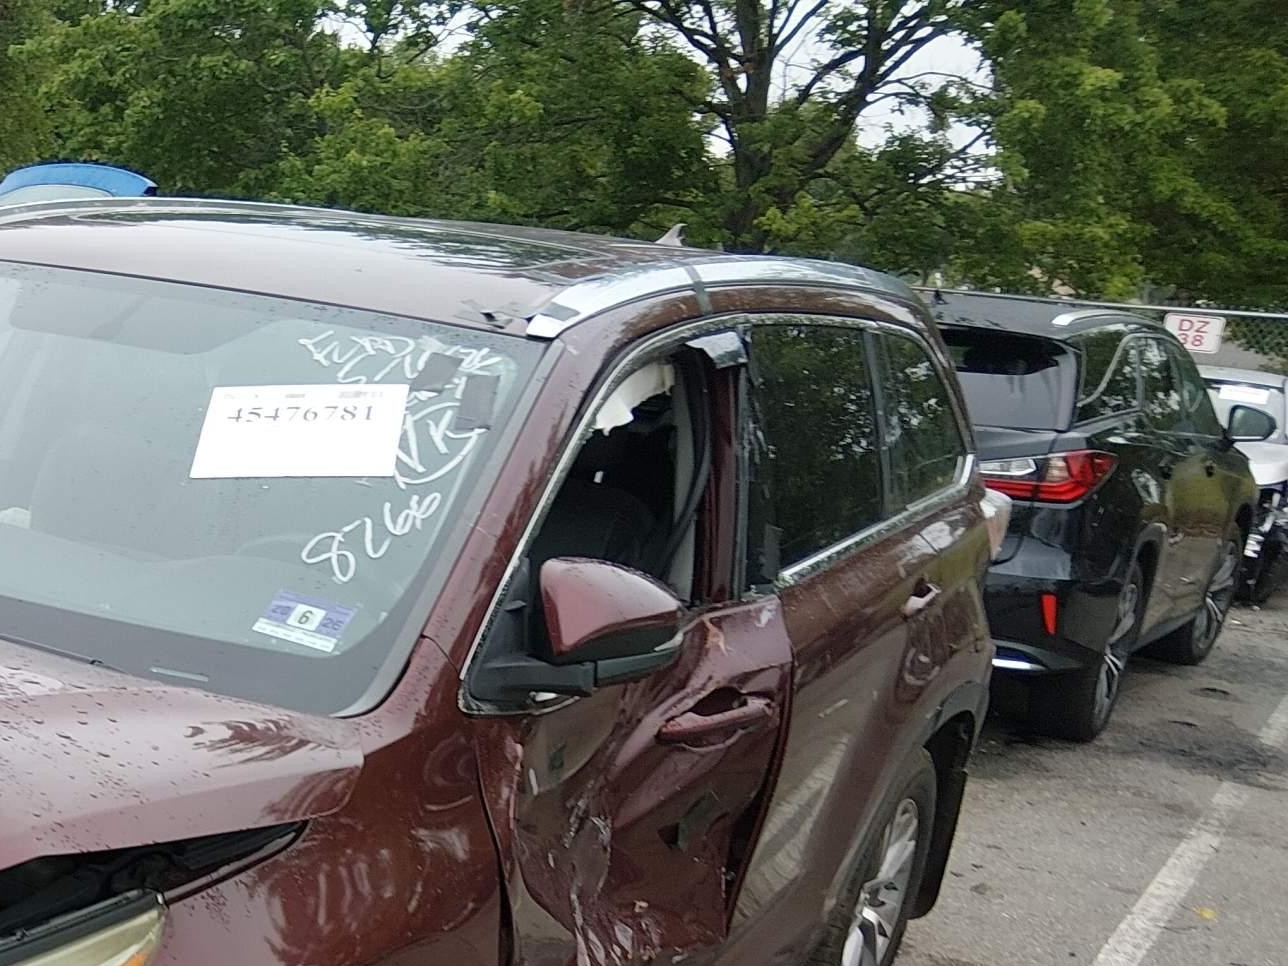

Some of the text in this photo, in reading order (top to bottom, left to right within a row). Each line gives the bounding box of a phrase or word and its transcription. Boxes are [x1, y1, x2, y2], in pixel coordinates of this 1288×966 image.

[1179, 319, 1209, 333] DZ
[1178, 333, 1204, 347] 38
[227, 405, 373, 422] 45476781
[301, 493, 441, 583] 8266
[298, 610, 314, 625] 6
